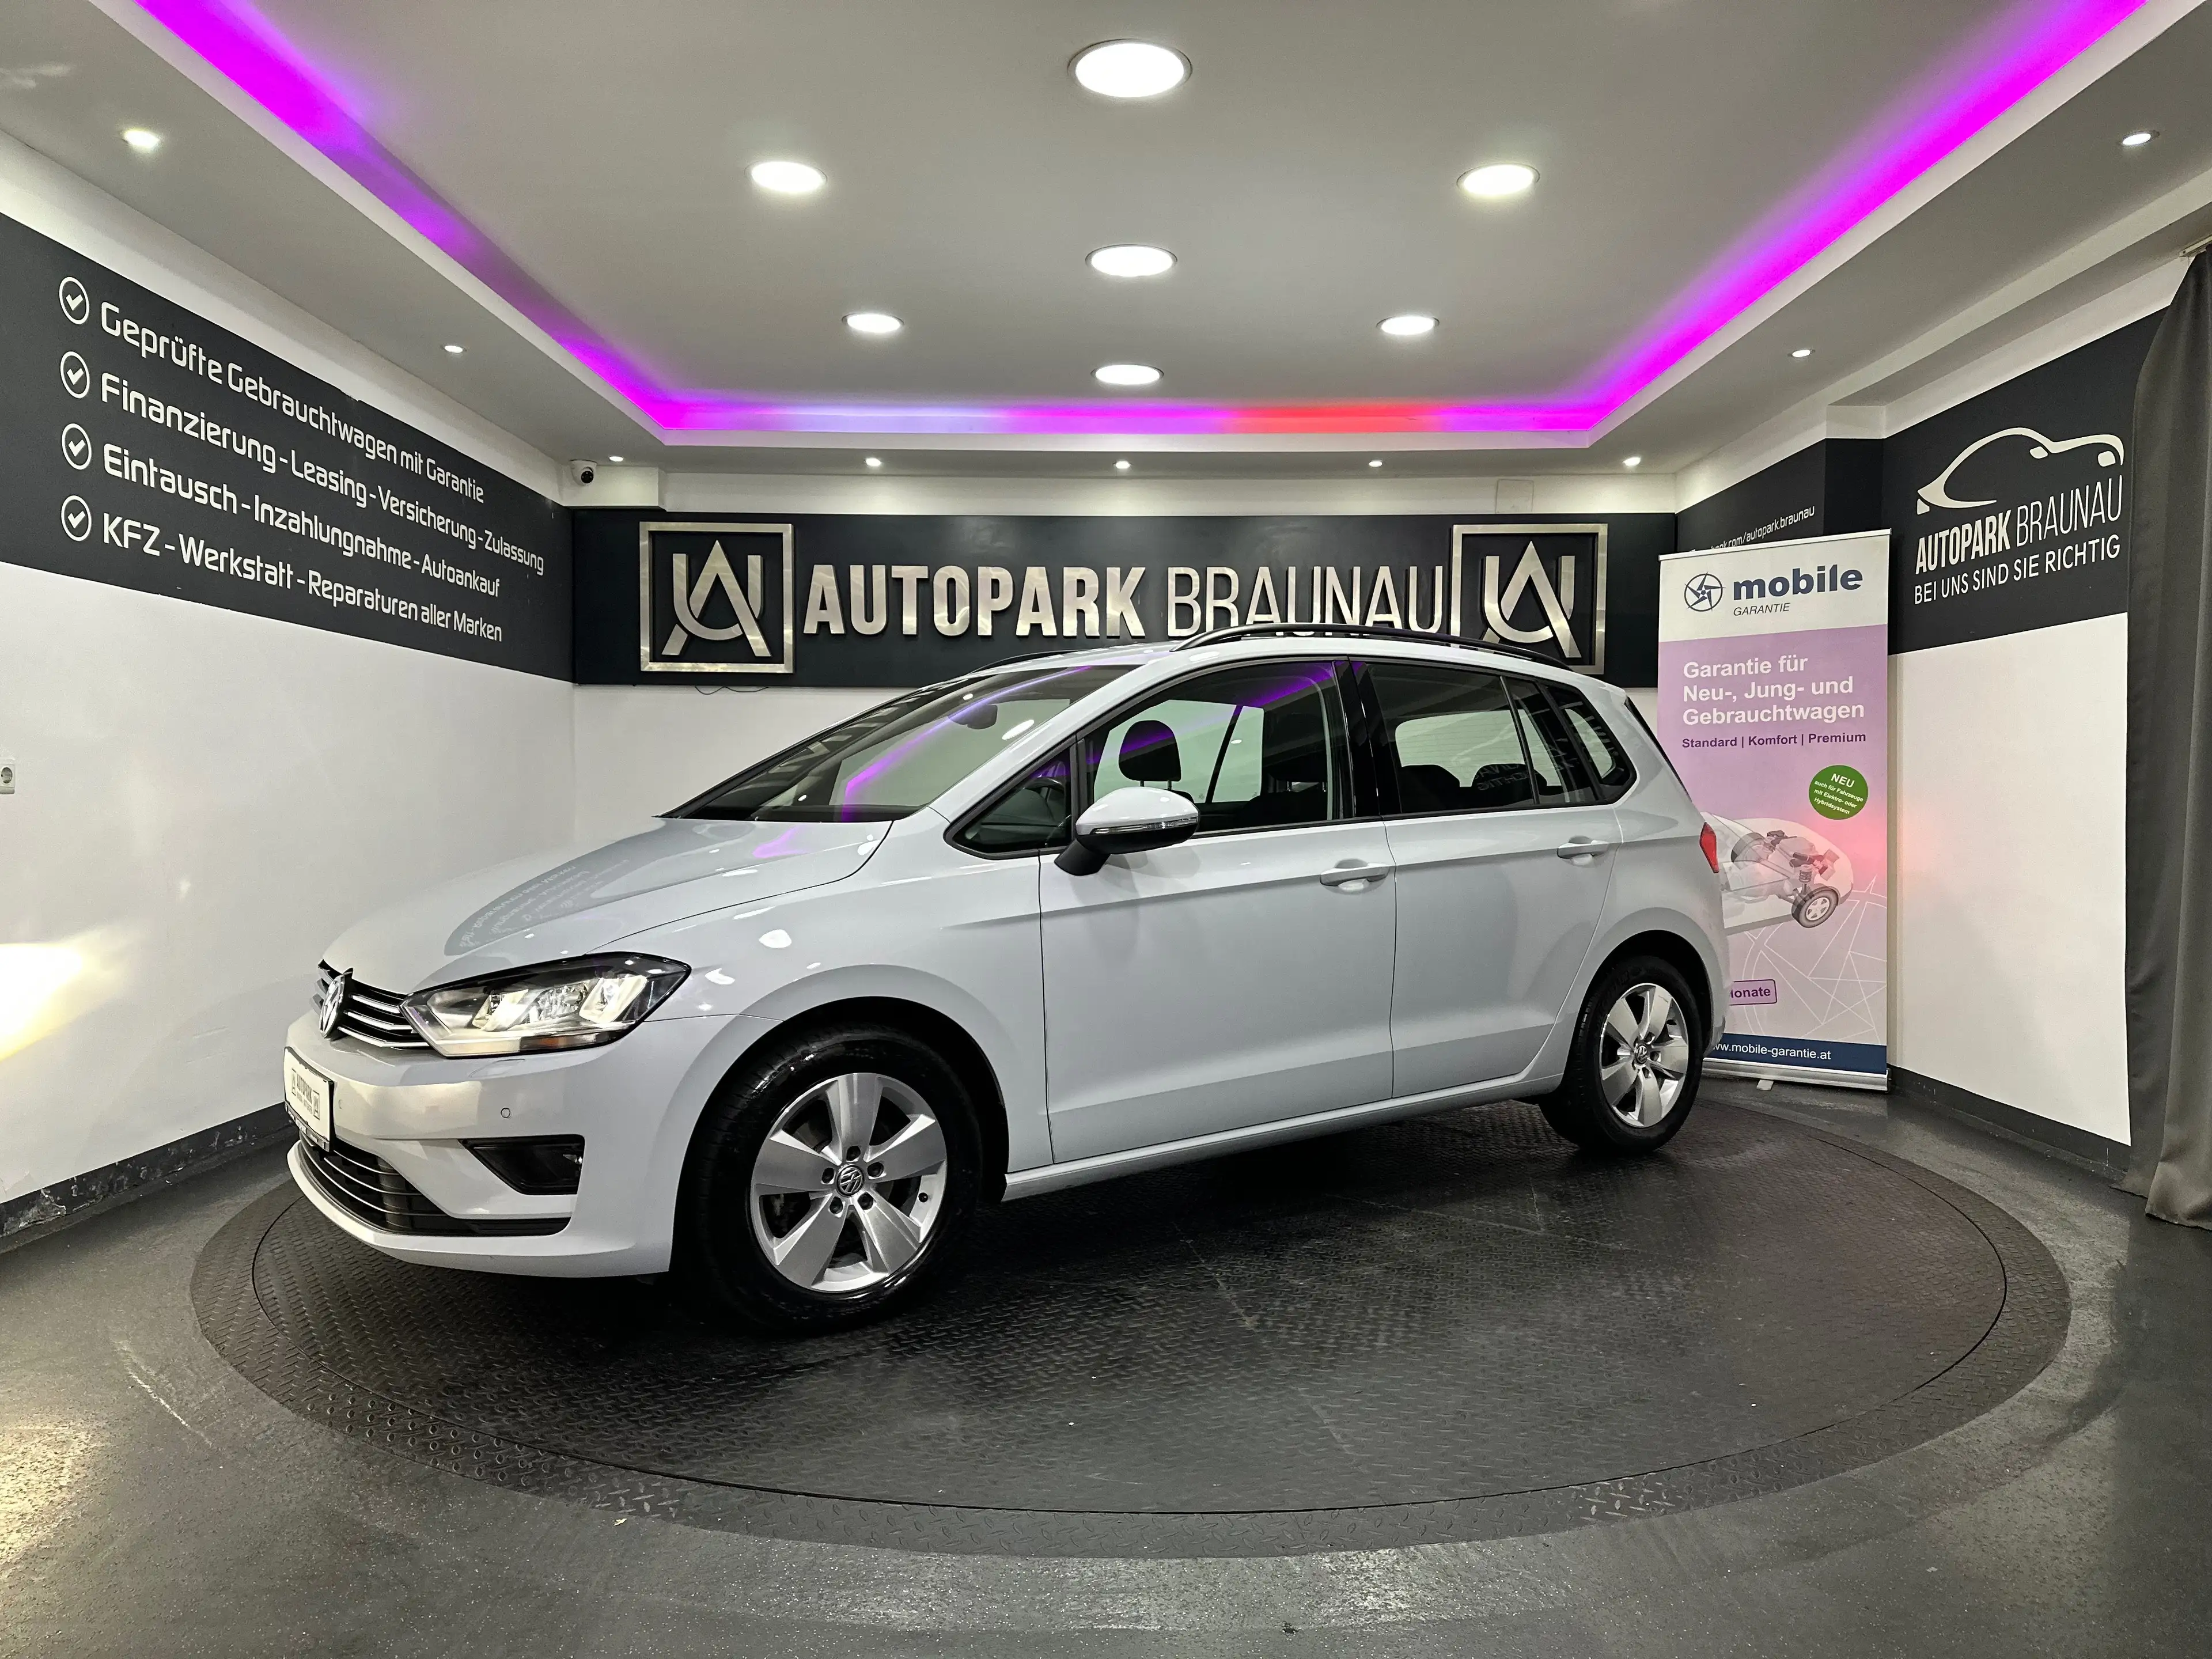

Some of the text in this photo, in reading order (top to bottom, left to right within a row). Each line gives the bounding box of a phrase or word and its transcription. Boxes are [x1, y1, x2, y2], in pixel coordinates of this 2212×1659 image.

[101, 302, 483, 503] Geprüfte Gebrauchtwagen mit Garantie
[102, 373, 275, 473] Finanzierung
[291, 450, 366, 508] Leasing
[378, 486, 476, 549] Versicherung
[485, 530, 543, 575] Zulassung
[104, 444, 237, 514] Eintausch
[255, 495, 411, 569] Inzahlungnahme
[422, 554, 499, 597] Autoankauf
[1915, 475, 2123, 574] AUTOPARK BRAUNAU
[104, 513, 160, 556] KFZ
[179, 533, 293, 589] Werkstatt
[309, 570, 417, 620] Reparaturen
[421, 604, 450, 628] aller
[454, 611, 501, 641] Marken
[1915, 534, 2121, 604] BEI UNS SIND SIE RICHTIG
[1733, 564, 1863, 601] mobile
[804, 565, 1443, 637] AUTOPARK BRAUNAU
[1733, 603, 1790, 616] GARANTIE
[1683, 654, 1808, 679] Garantie für
[1683, 676, 1853, 703] Neu-, Jung- und
[1683, 704, 1864, 725] Gebrauchtwagen
[1682, 737, 1737, 748] Standard
[1748, 734, 1798, 746] Komfort
[1808, 733, 1866, 744] Premium
[1831, 773, 1855, 787] NEU
[1814, 797, 1850, 815] Hybridsystem
[1823, 791, 1844, 802] Elektro-
[1836, 788, 1863, 802] Fahrzeuge
[1713, 1043, 1831, 1060] ww.mobile-garantie.at
